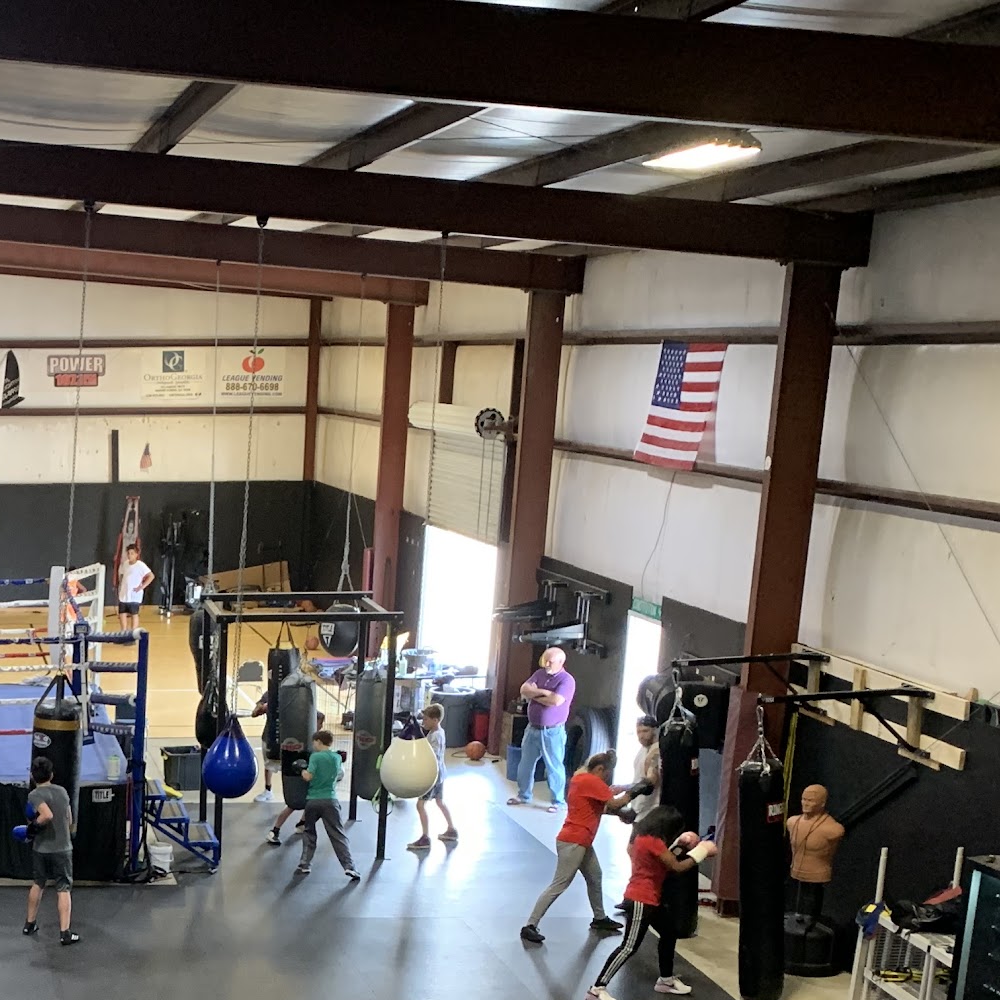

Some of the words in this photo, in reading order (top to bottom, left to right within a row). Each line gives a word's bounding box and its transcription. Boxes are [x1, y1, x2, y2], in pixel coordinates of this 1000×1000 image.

[49, 357, 103, 373] POWER
[225, 382, 279, 391] 888-670-6698
[94, 790, 109, 799] TITLE
